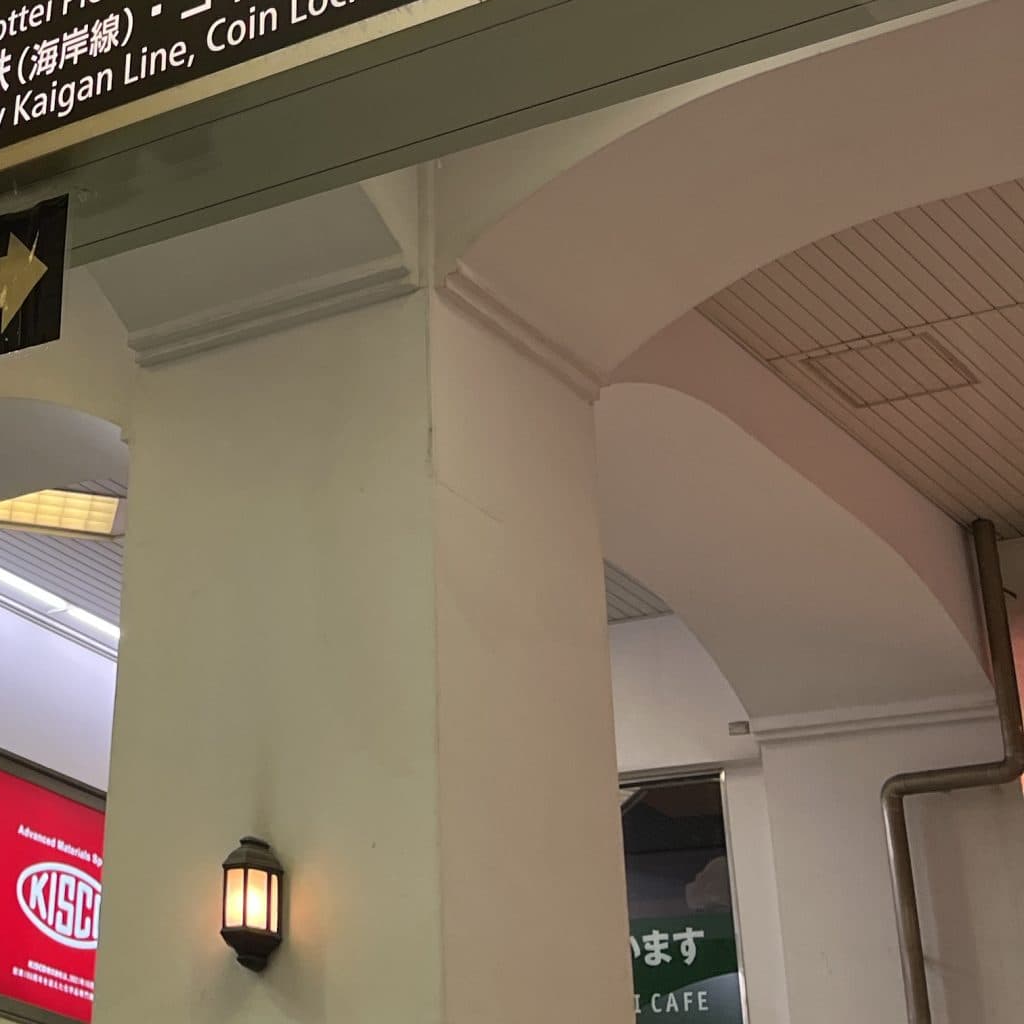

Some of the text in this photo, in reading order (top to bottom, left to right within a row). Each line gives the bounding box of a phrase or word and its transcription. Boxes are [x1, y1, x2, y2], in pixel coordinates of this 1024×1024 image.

[13, 68, 113, 126] Kaigan
[124, 34, 195, 86] Line,
[207, 6, 278, 52] Coin
[18, 824, 56, 849] Advanced
[57, 839, 91, 862] Materials
[29, 872, 101, 940] KISC
[651, 991, 709, 1013] CAFE
